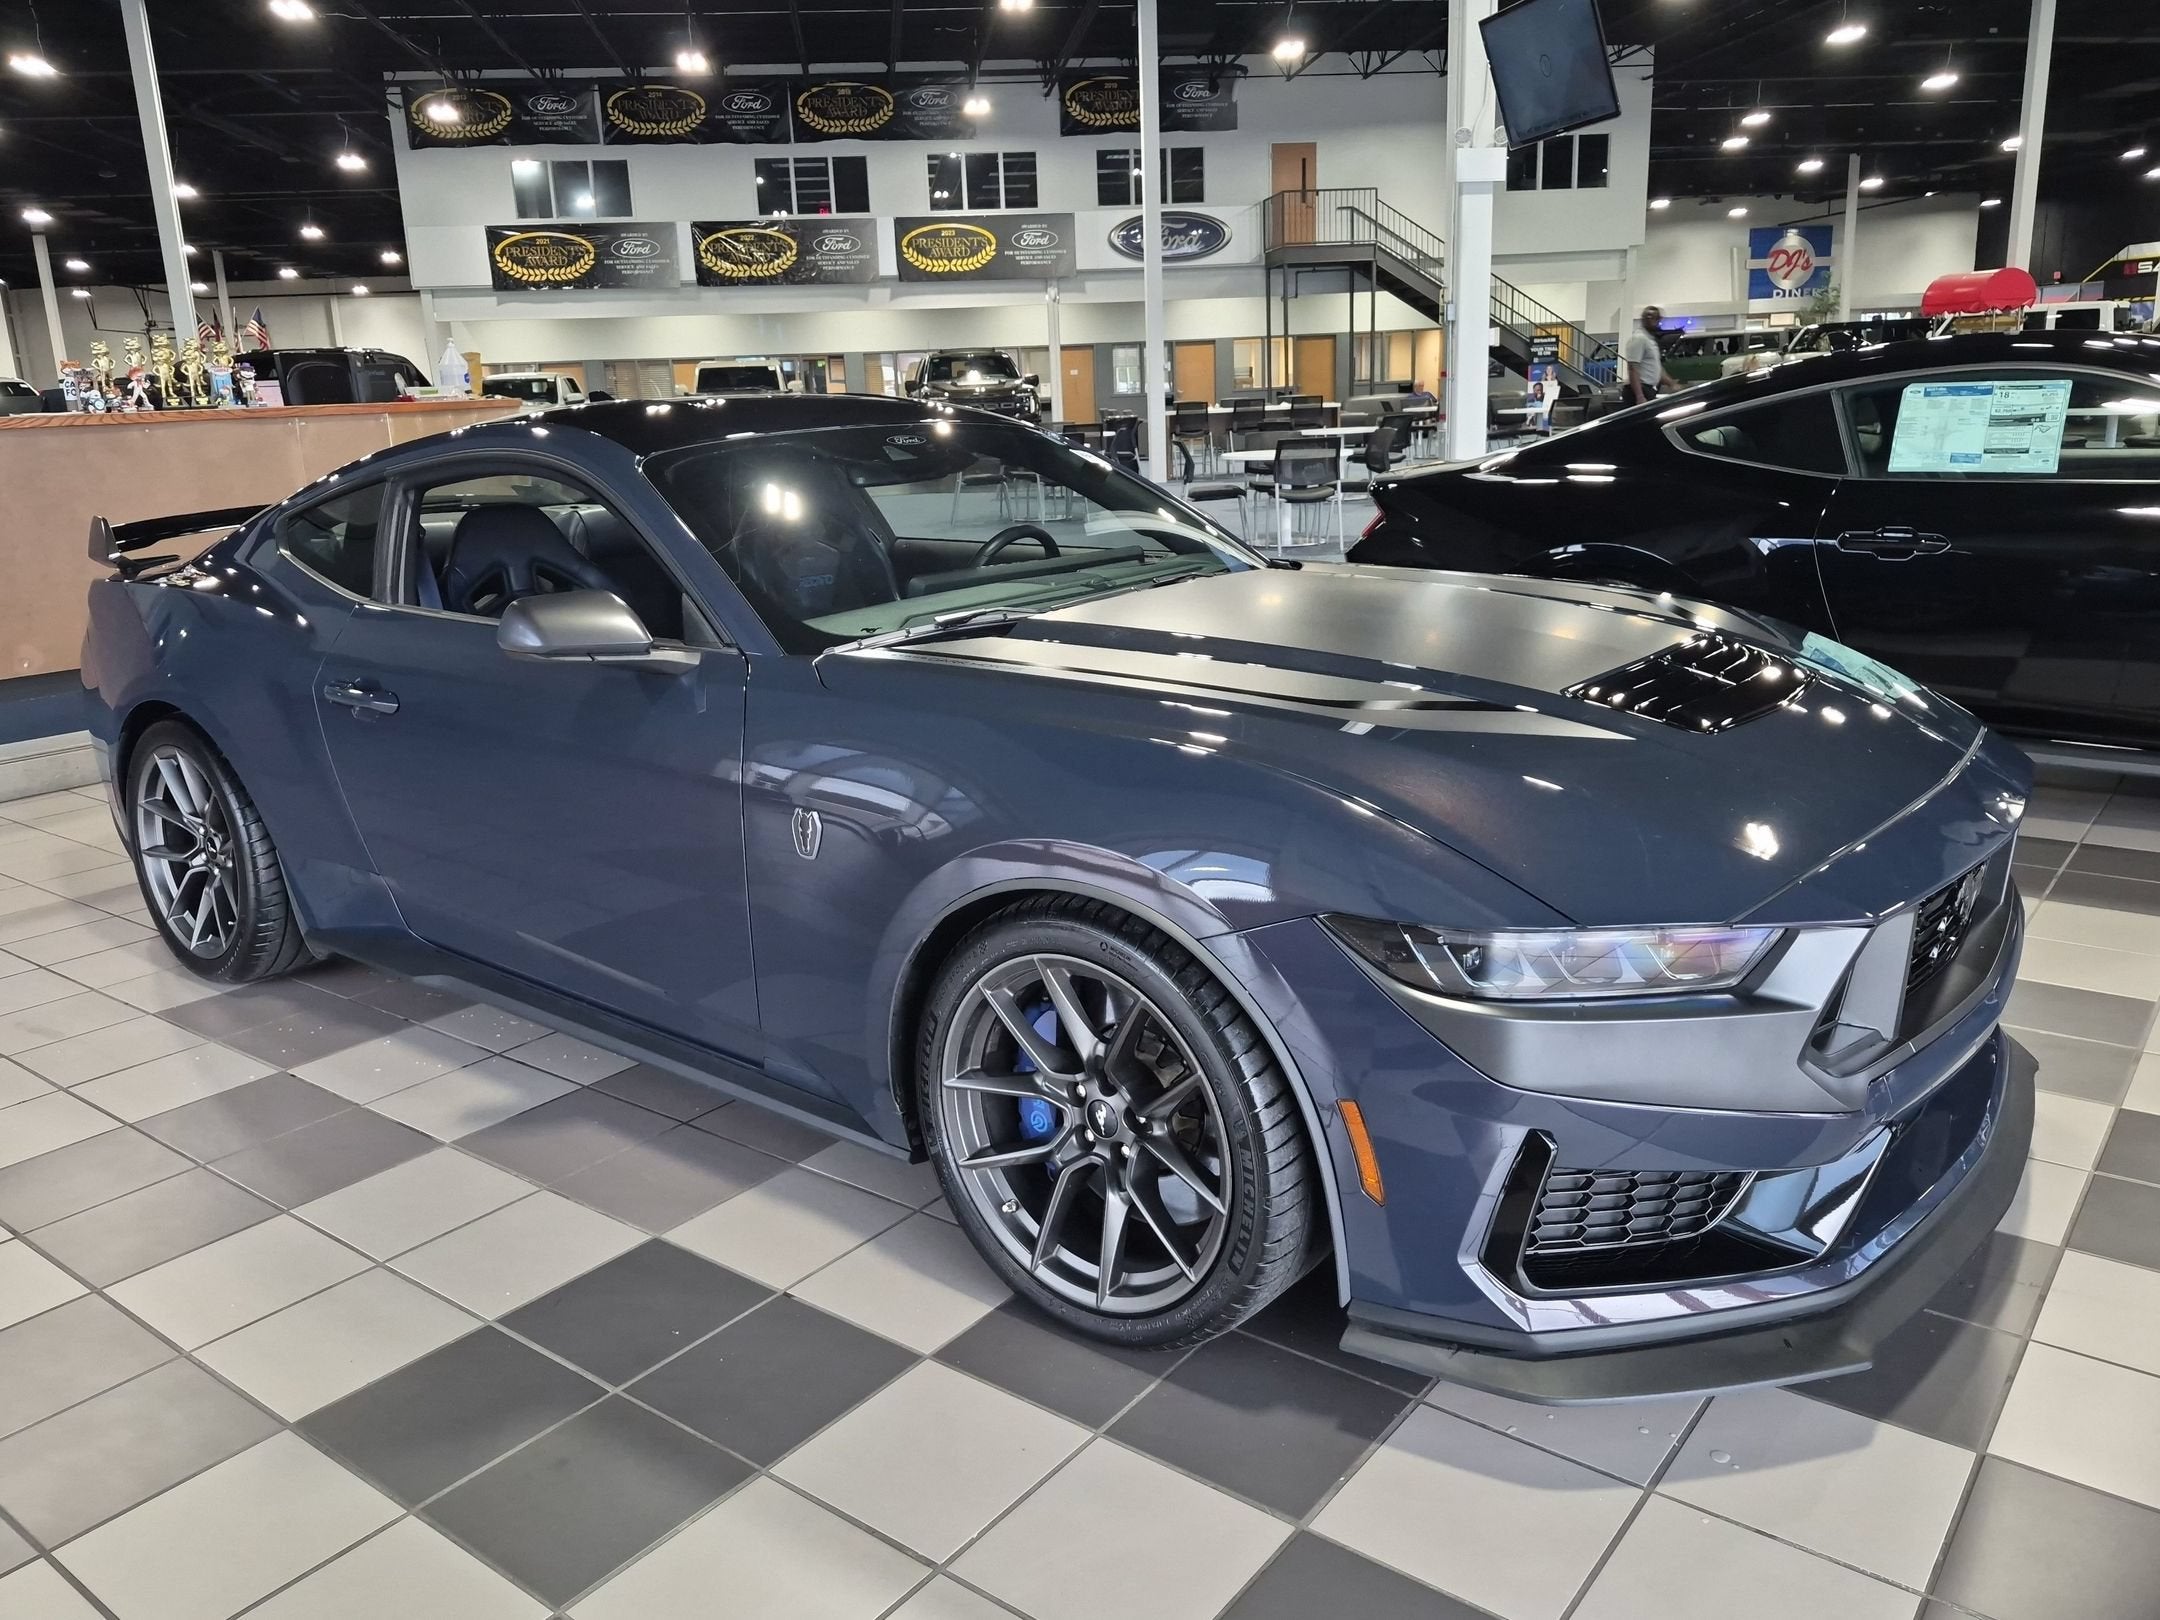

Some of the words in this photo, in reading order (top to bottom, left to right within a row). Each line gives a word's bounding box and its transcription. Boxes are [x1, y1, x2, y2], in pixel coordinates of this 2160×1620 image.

[537, 96, 567, 110] Ford
[731, 95, 762, 109] Ford
[919, 91, 949, 105] Ford
[822, 237, 852, 250] Ford
[912, 237, 988, 249] PRESIDENT'S
[1020, 232, 1050, 245] Ford
[505, 245, 587, 258] PRESIDENT'S
[620, 241, 651, 254] Ford
[929, 247, 971, 258] AWARD
[525, 256, 568, 267] AWARD
[894, 436, 921, 445] Ford
[1228, 1148, 1256, 1275] MICHELIN
